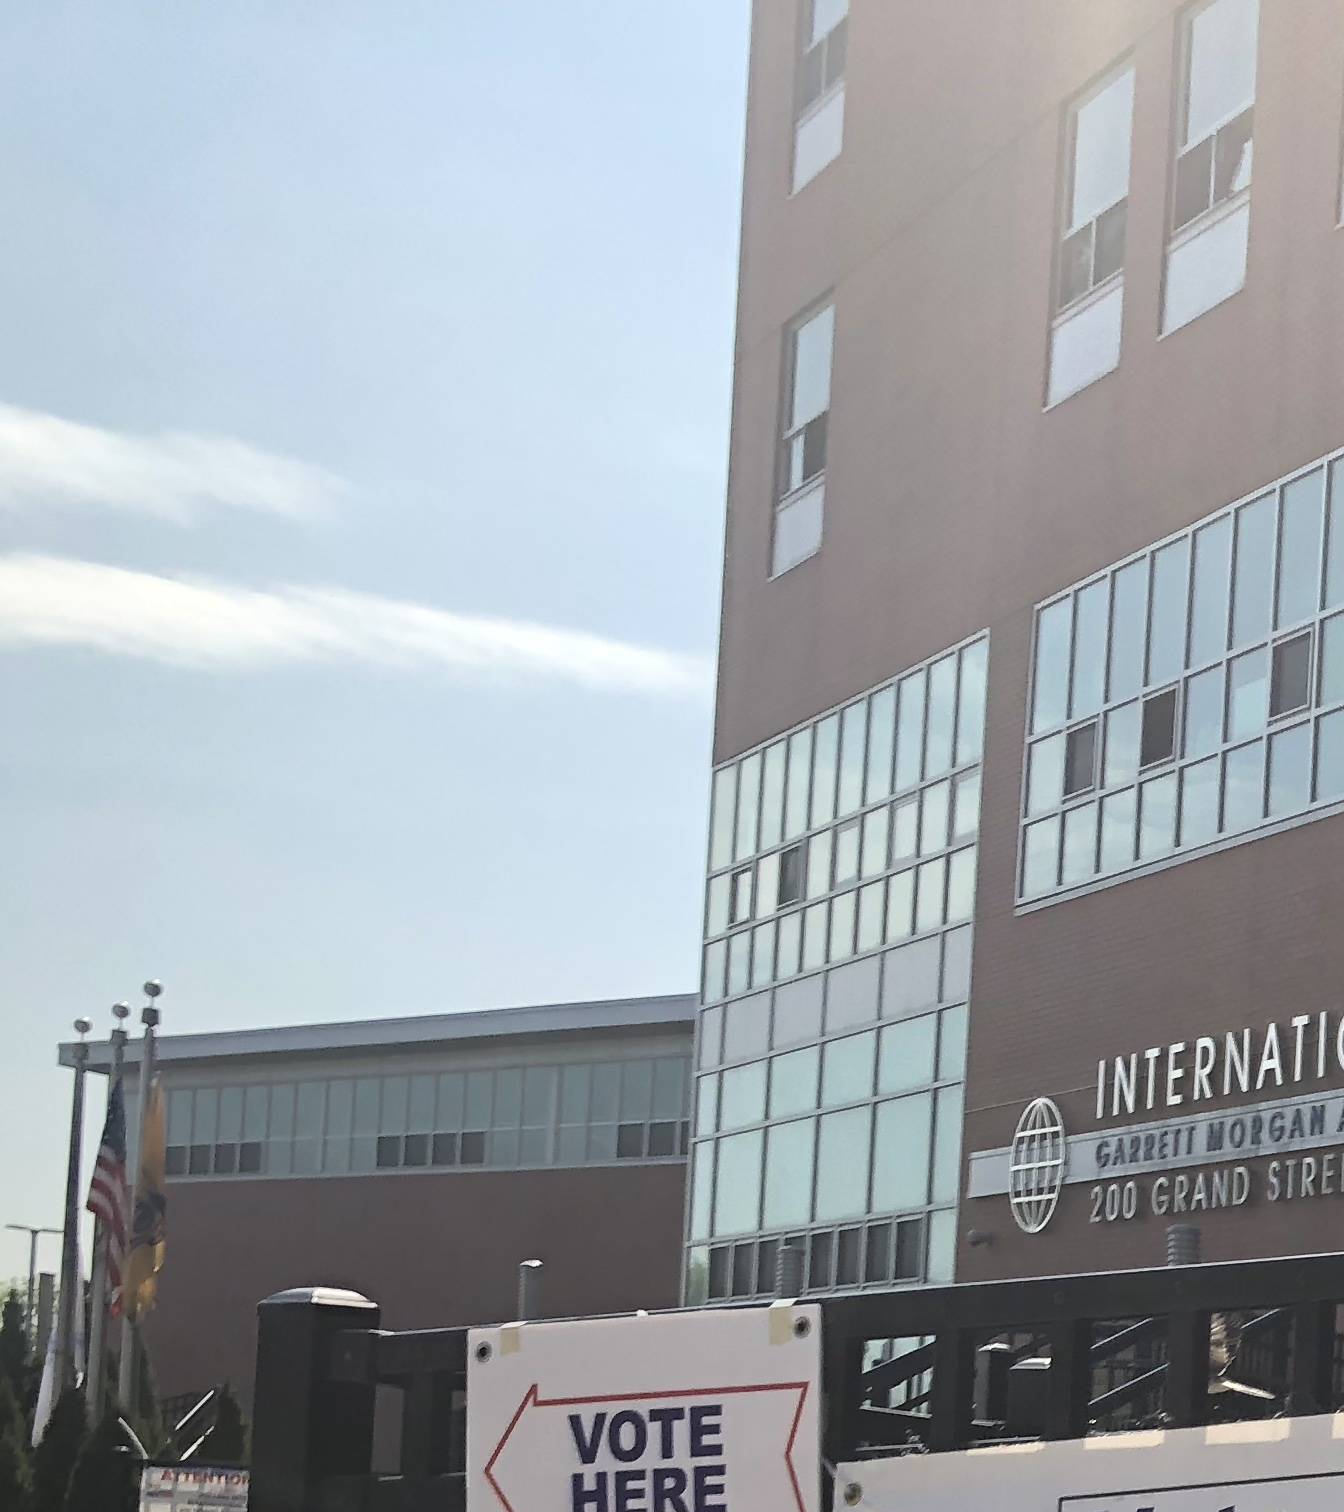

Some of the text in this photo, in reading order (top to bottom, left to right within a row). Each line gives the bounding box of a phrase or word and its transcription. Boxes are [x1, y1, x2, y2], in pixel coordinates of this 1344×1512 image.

[1095, 1125, 1197, 1170] GARRETT
[1206, 1099, 1327, 1152] MORGAN
[1089, 1179, 1138, 1224] 200
[1151, 1165, 1251, 1217] GRAND
[567, 1404, 723, 1465] VOTE
